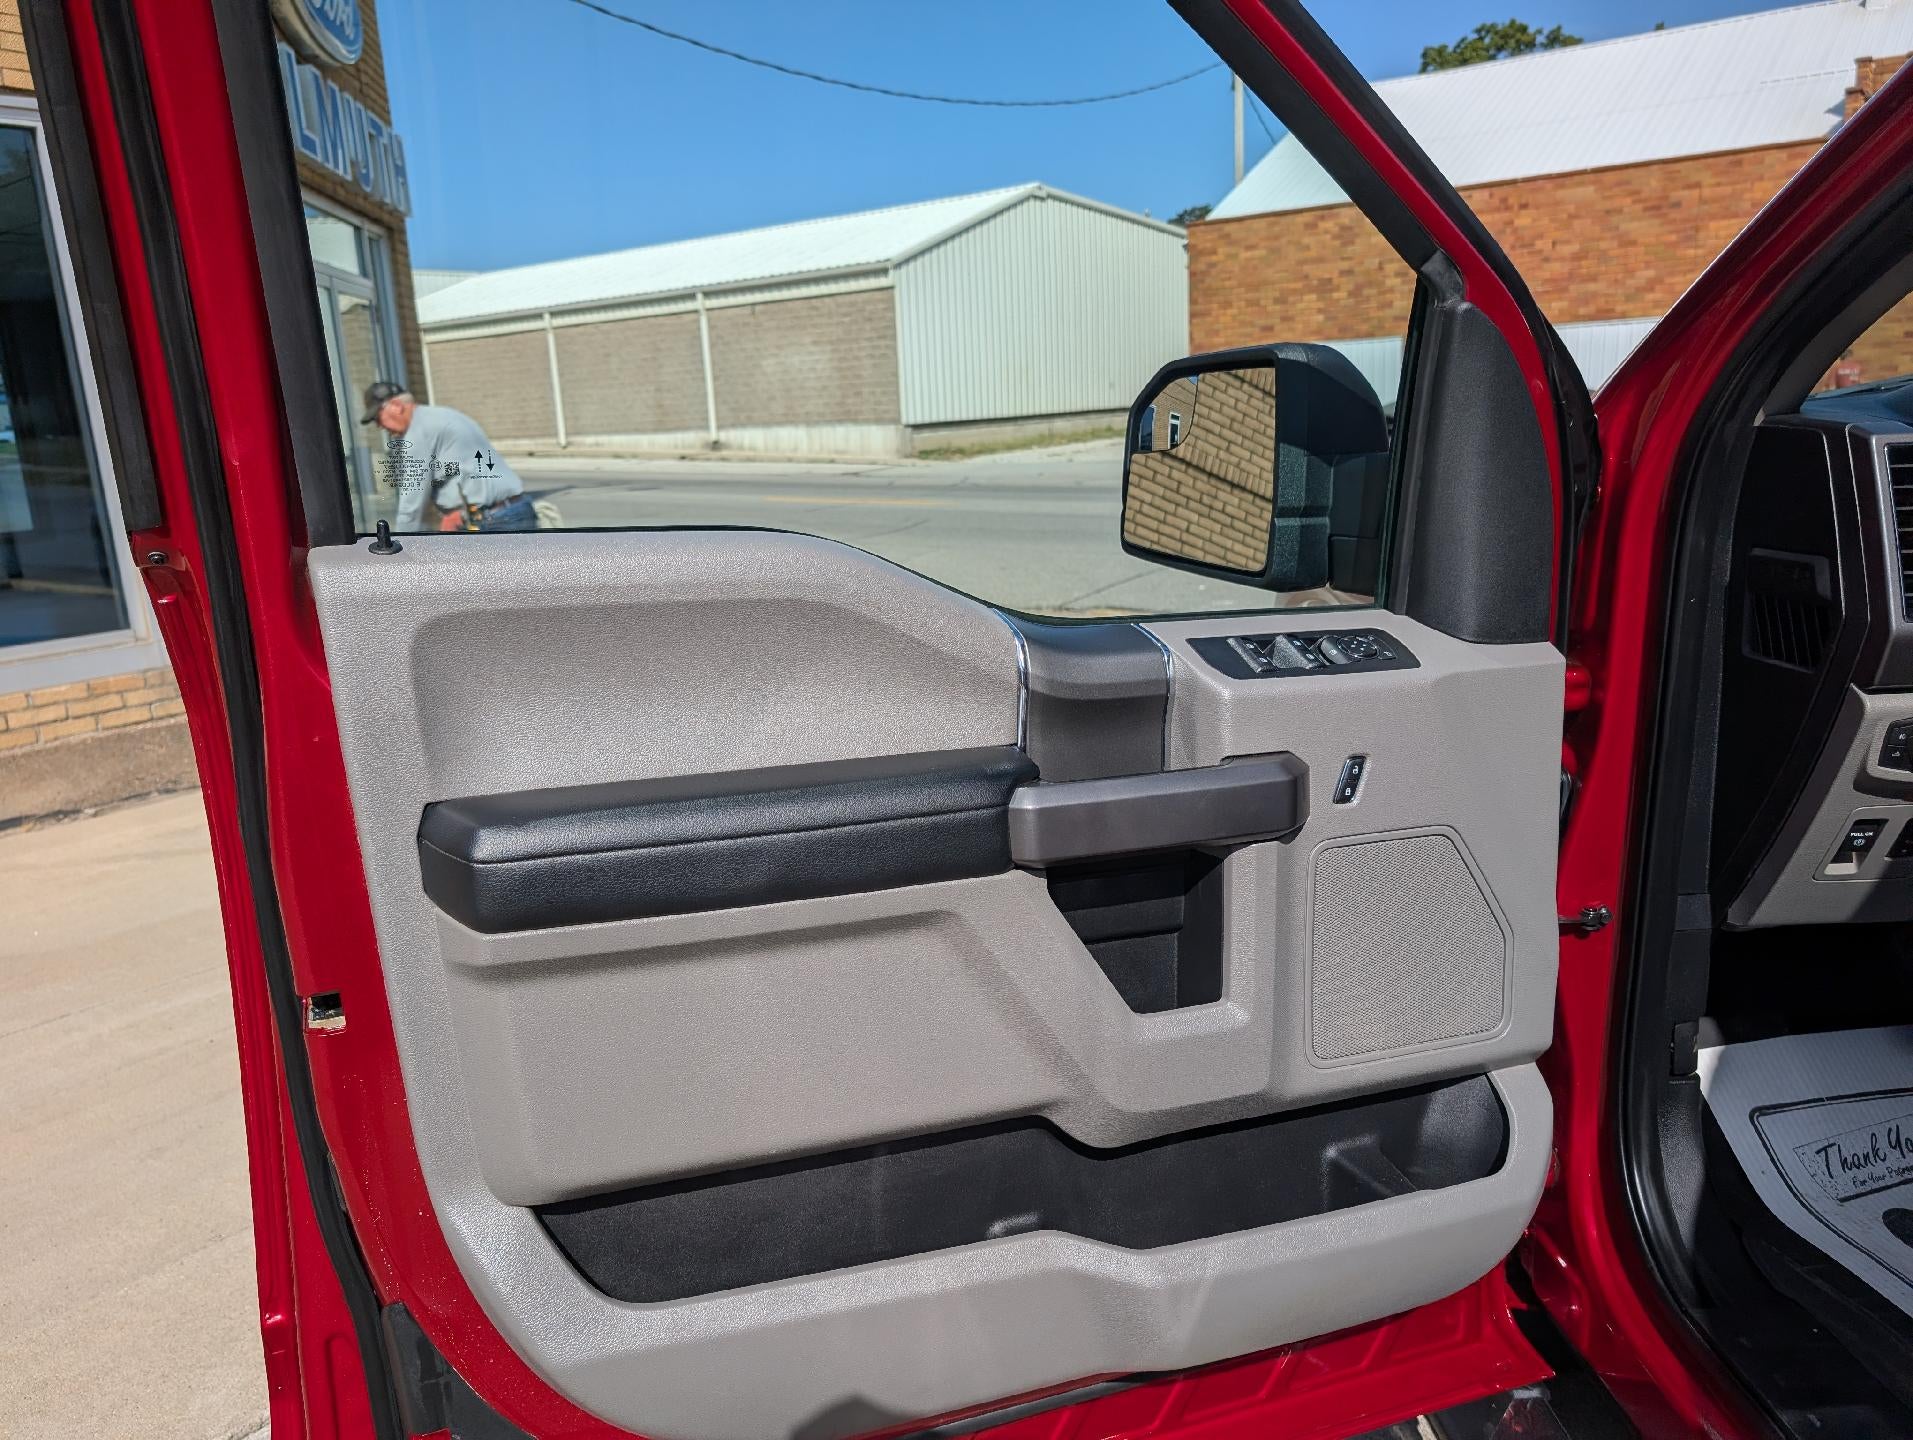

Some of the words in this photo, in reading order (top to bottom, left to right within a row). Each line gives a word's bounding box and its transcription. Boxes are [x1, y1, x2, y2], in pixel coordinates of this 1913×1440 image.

[310, 0, 355, 40] ord
[1815, 1132, 1887, 1180] Thank
[1851, 1175, 1867, 1188] For
